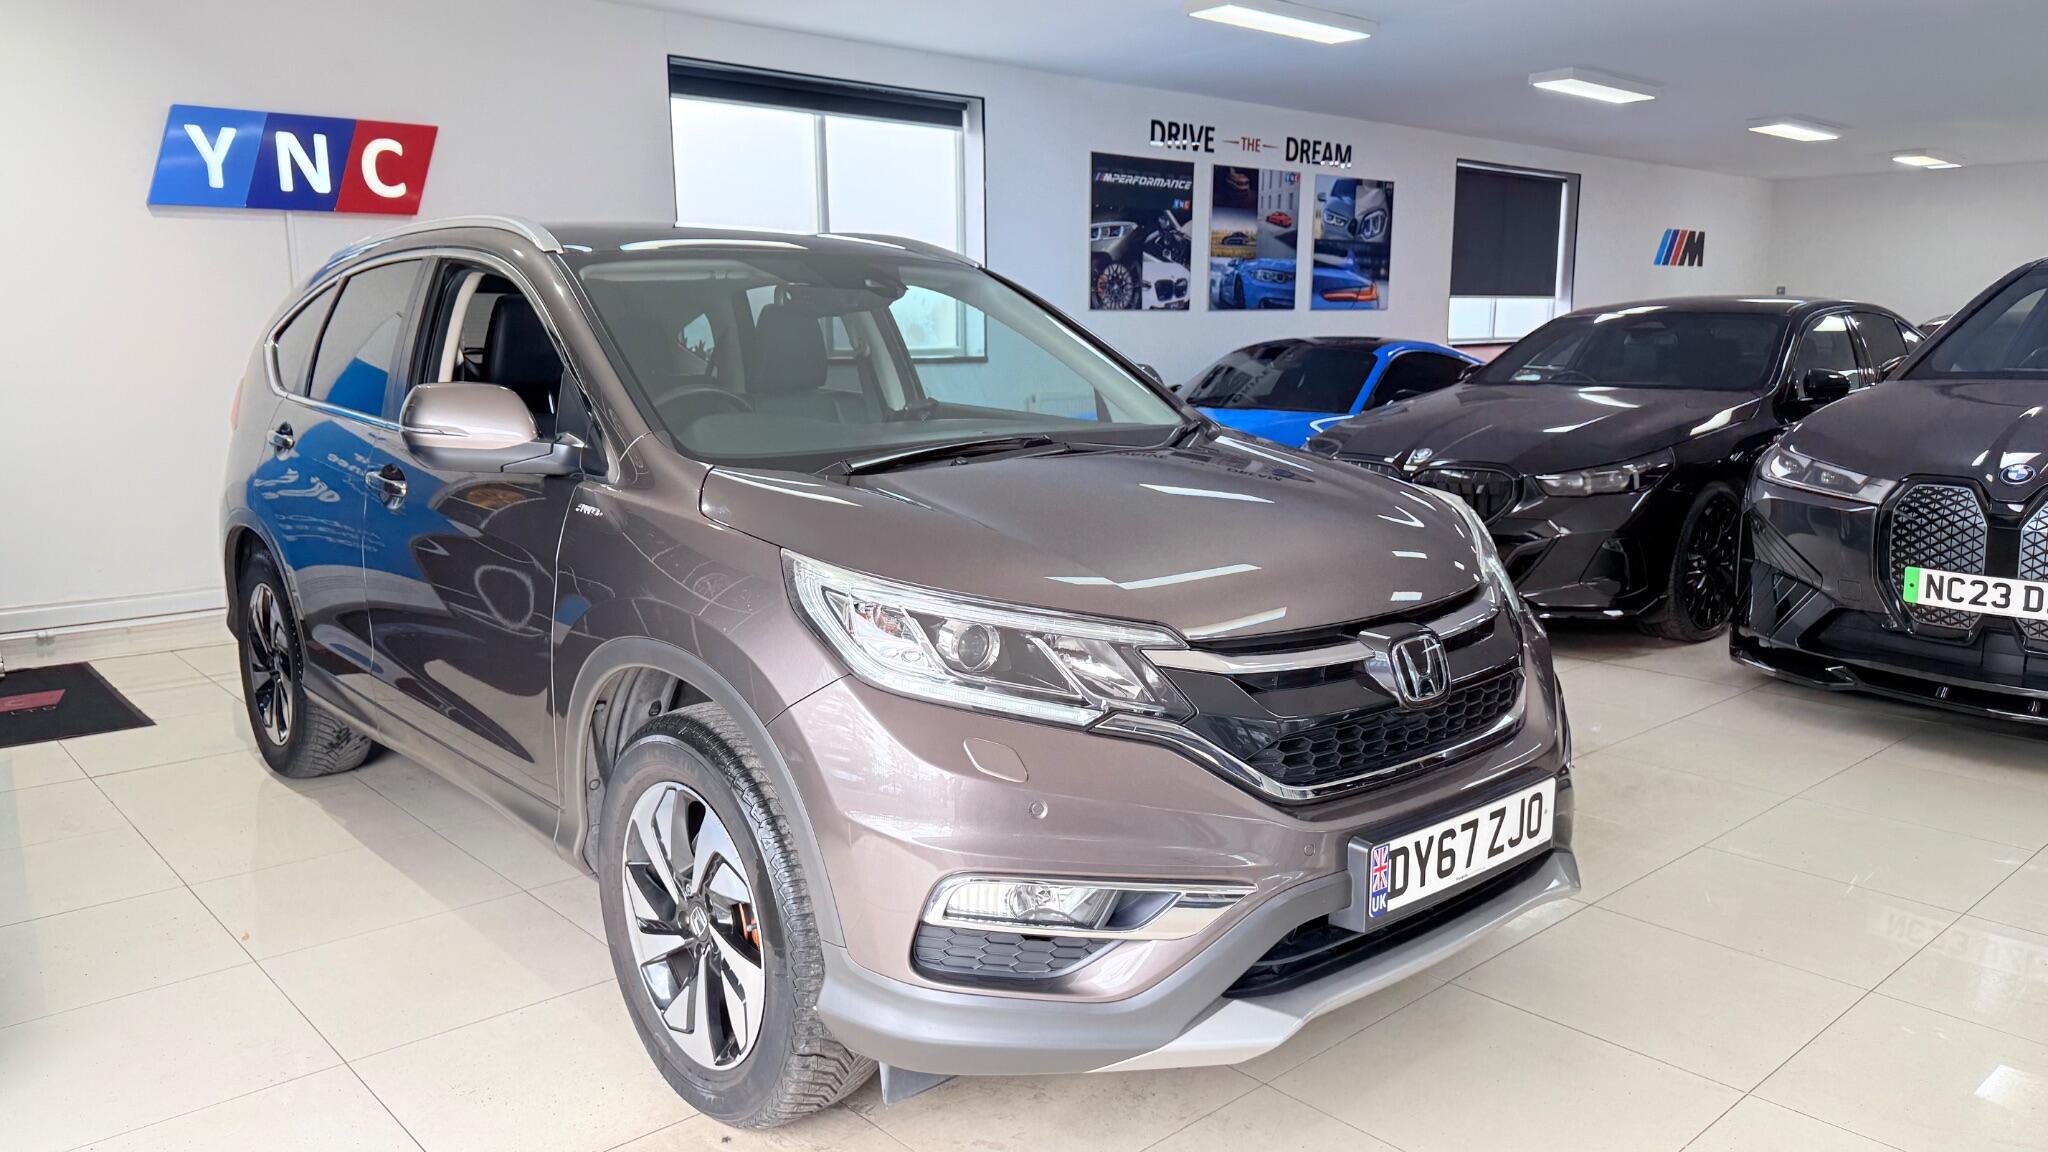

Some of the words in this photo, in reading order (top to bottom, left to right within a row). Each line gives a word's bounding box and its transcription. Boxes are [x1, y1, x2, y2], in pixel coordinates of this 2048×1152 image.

[183, 123, 407, 199] YNC
[1150, 118, 1216, 154] DRIVE
[1241, 136, 1261, 153] THE
[1285, 136, 1352, 169] DREAM
[1925, 573, 2012, 609] NC23
[2022, 584, 2048, 613] D
[1387, 817, 1479, 901] DY67
[1487, 791, 1543, 859] ZJO
[1372, 892, 1387, 912] UK
